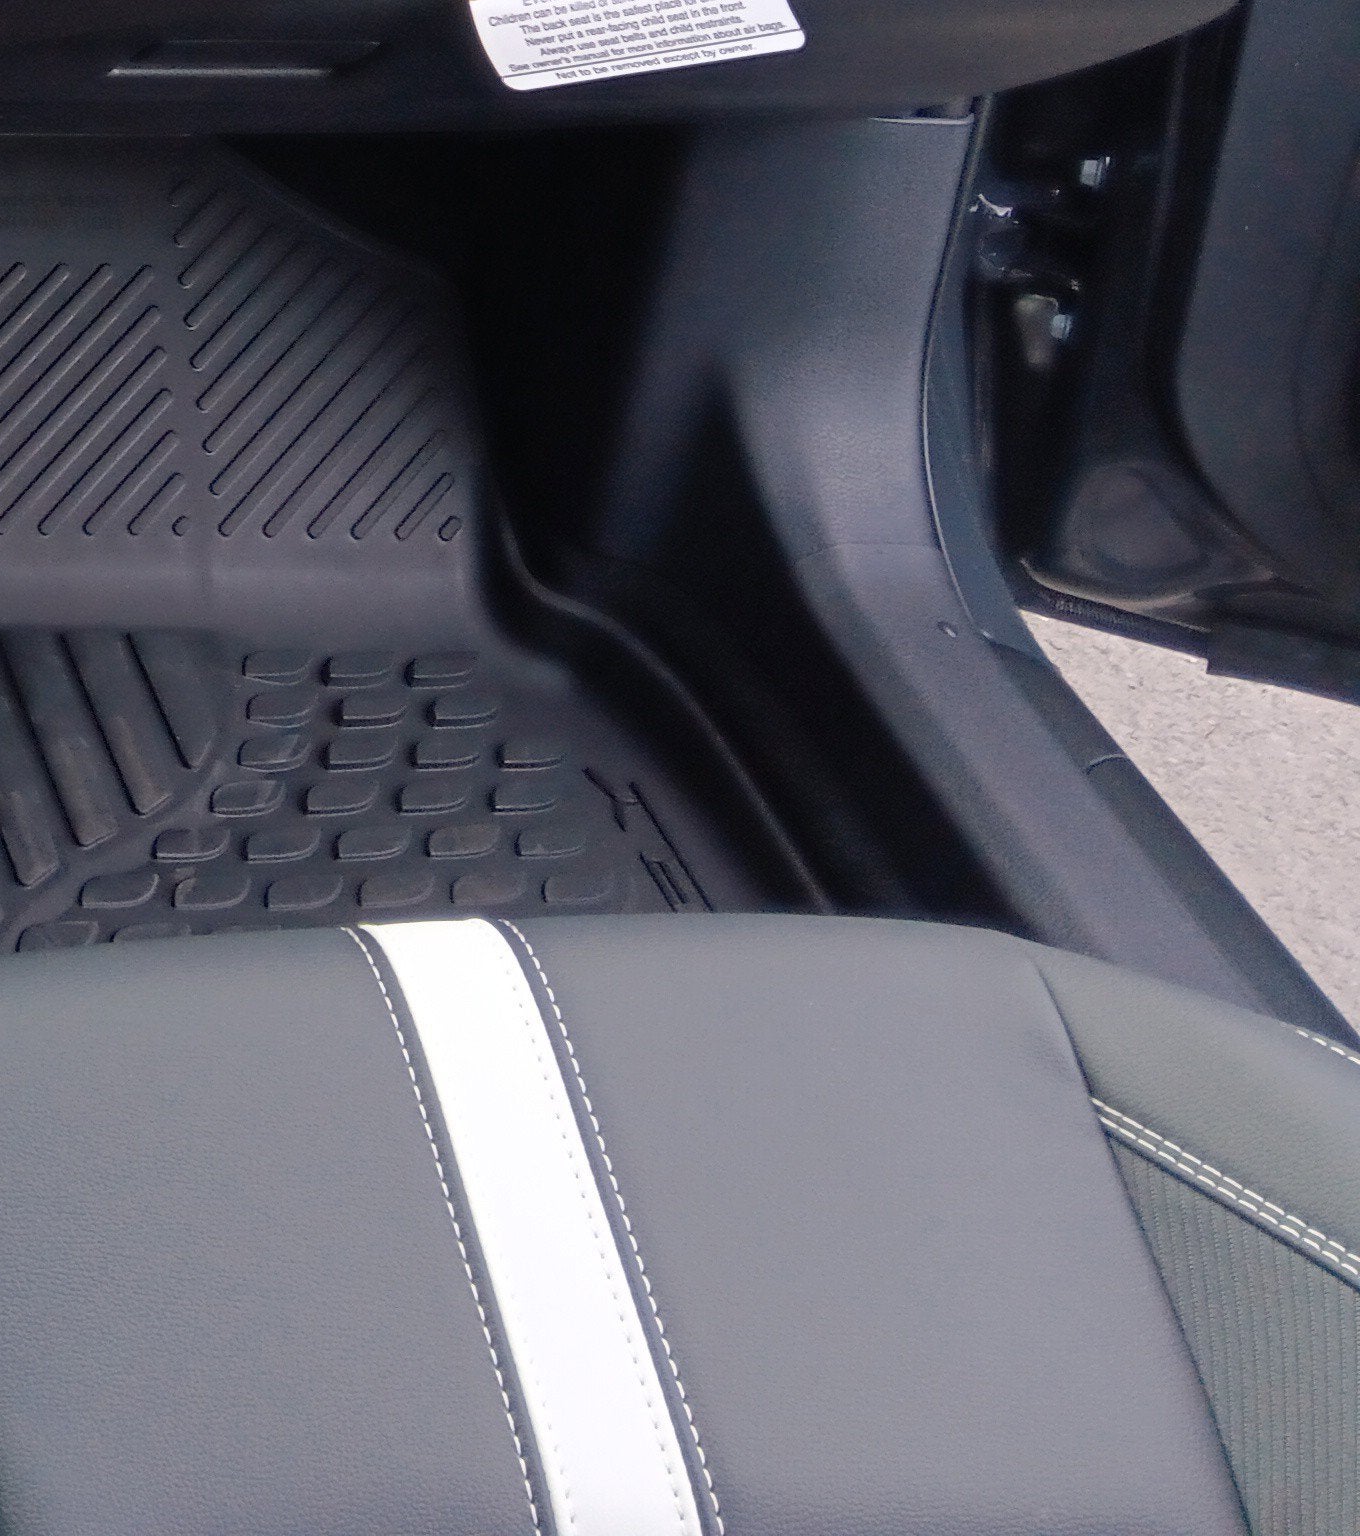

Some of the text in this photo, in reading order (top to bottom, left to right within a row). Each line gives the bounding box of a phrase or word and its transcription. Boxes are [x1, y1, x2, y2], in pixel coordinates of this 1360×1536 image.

[488, 13, 531, 27] Children
[533, 8, 552, 18] can
[553, 5, 568, 15] be
[519, 25, 541, 34] The
[542, 19, 568, 31] back
[569, 15, 591, 26] seat
[603, 10, 620, 20] the
[622, 4, 653, 17] safest
[655, 0, 683, 13] place
[524, 35, 555, 46] Never
[557, 32, 576, 43] put
[641, 14, 666, 27] child
[666, 11, 690, 23] seat
[701, 6, 719, 16] the
[540, 44, 577, 57] Always
[648, 27, 669, 39] and
[669, 23, 694, 35] child
[655, 33, 713, 49] information
[713, 27, 743, 40] about
[663, 51, 701, 64] except
[701, 49, 716, 58] by
